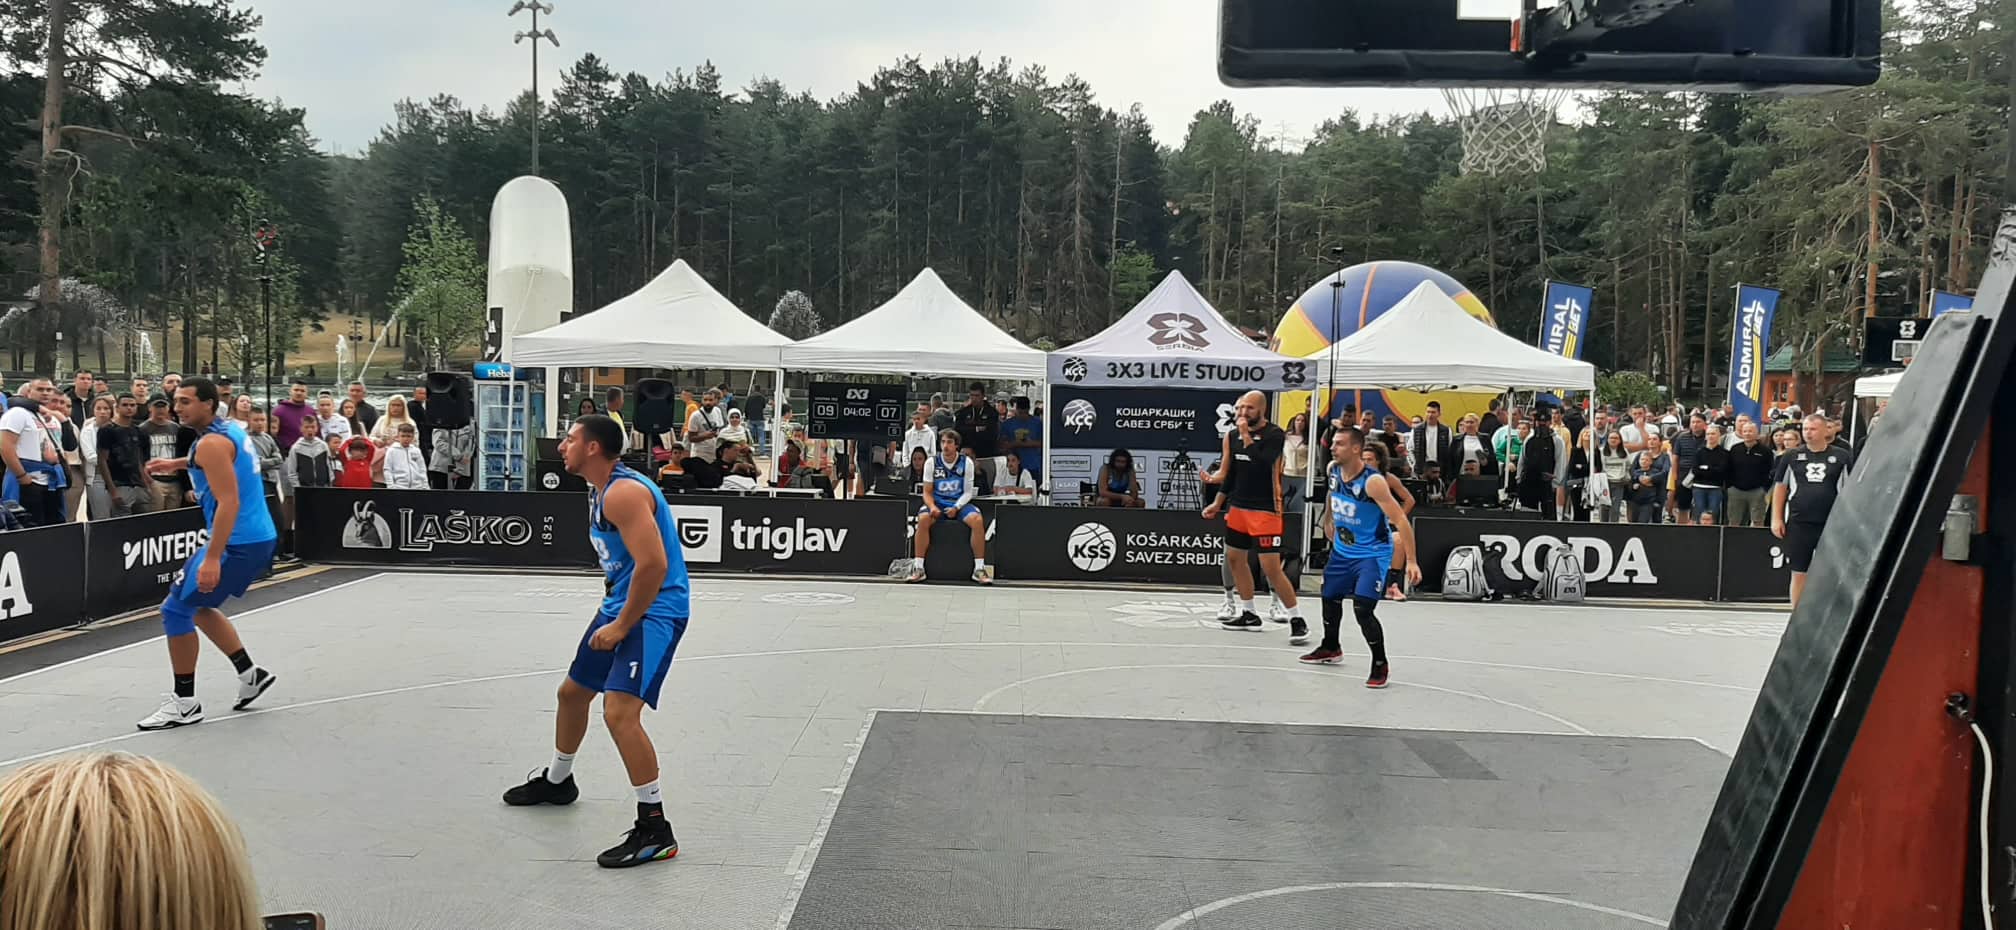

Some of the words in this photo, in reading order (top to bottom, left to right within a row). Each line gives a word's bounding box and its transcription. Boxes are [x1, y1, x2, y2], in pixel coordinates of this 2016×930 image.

[1567, 298, 1582, 335] BET
[1753, 301, 1766, 336] BET
[1735, 300, 1757, 396] ADMIRAL
[1106, 361, 1145, 379] 3X3
[1150, 362, 1190, 380] LIVE
[1197, 363, 1266, 382] STUDIO
[817, 405, 835, 416] 09
[843, 407, 872, 417] 04:02
[880, 407, 897, 418] 07
[1115, 407, 1196, 418] КОШАРКАШКИ
[1115, 419, 1152, 429] САВЕЗ
[1153, 420, 1195, 431] СРБИЕ
[934, 469, 946, 478] 34
[399, 508, 534, 552] LAŠKO
[541, 515, 554, 545] 1825
[730, 517, 849, 560] triglav
[1072, 544, 1112, 560] KSS
[1125, 551, 1173, 564] SAVEZ
[1479, 534, 1658, 585] RODA
[628, 660, 640, 679] 1
